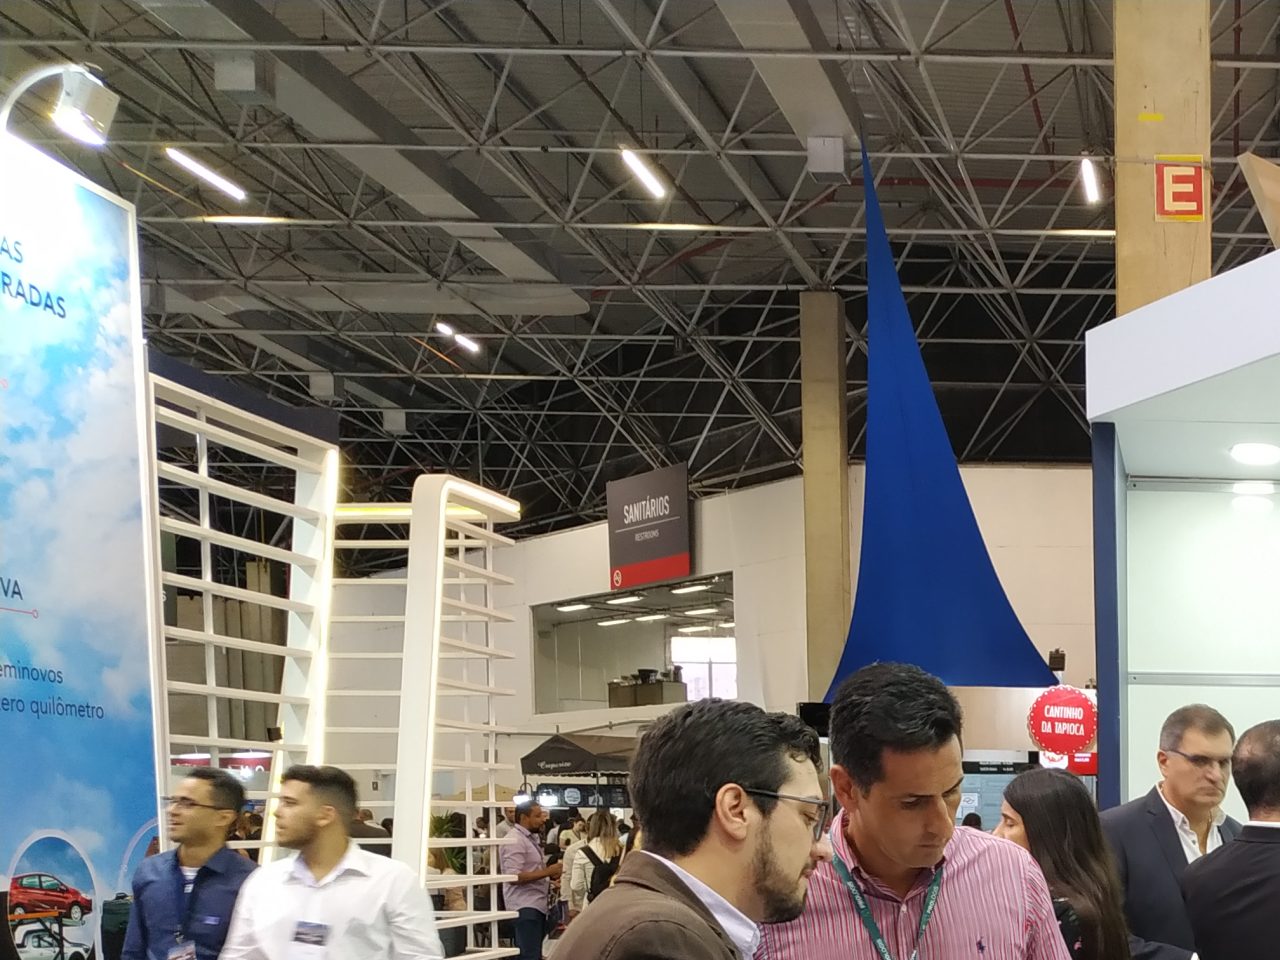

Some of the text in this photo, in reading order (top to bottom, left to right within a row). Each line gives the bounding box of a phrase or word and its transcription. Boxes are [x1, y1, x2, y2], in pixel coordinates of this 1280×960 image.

[1163, 166, 1197, 211] E
[1, 271, 66, 319] RADAS
[623, 496, 670, 524] SANITÁRIOS
[634, 528, 660, 542] RESTROOMS
[0, 695, 104, 720] ero quilômetro
[1044, 705, 1084, 720] CANTINHO
[1041, 721, 1085, 736] DA TAPIOCA
